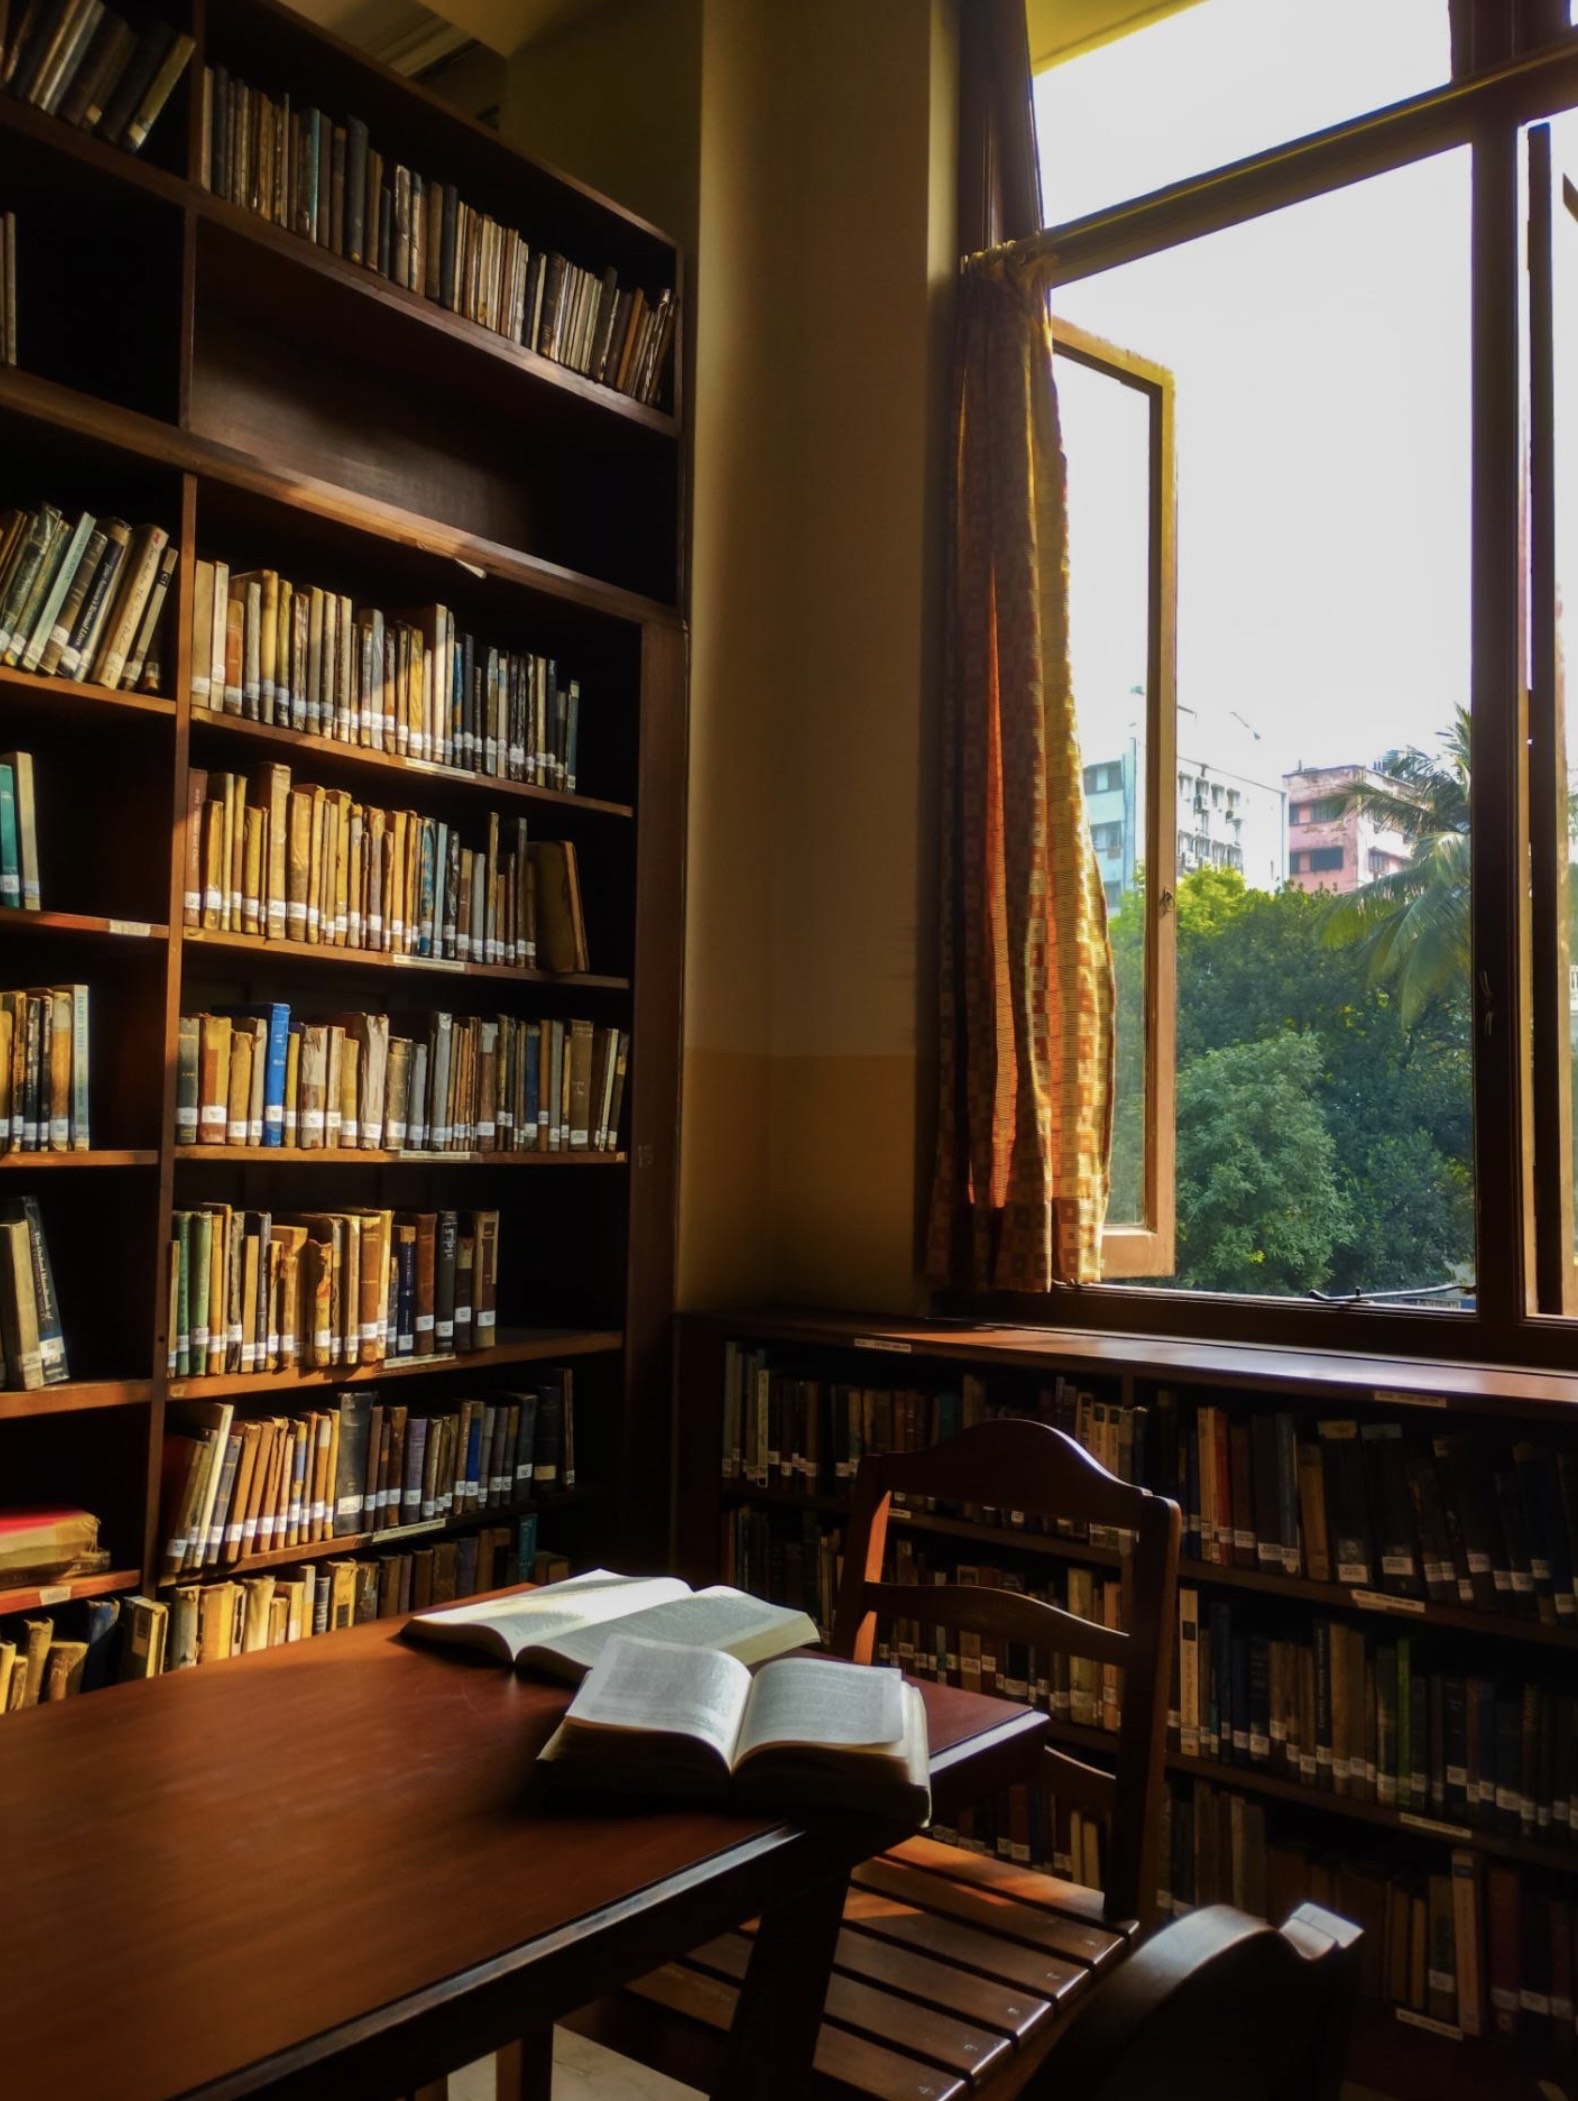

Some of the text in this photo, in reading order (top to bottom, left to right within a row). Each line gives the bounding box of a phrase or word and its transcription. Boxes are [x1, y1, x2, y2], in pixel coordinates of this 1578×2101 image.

[34, 1230, 42, 1246] The
[37, 1246, 46, 1272] Oxford
[41, 1271, 52, 1309] Handbook
